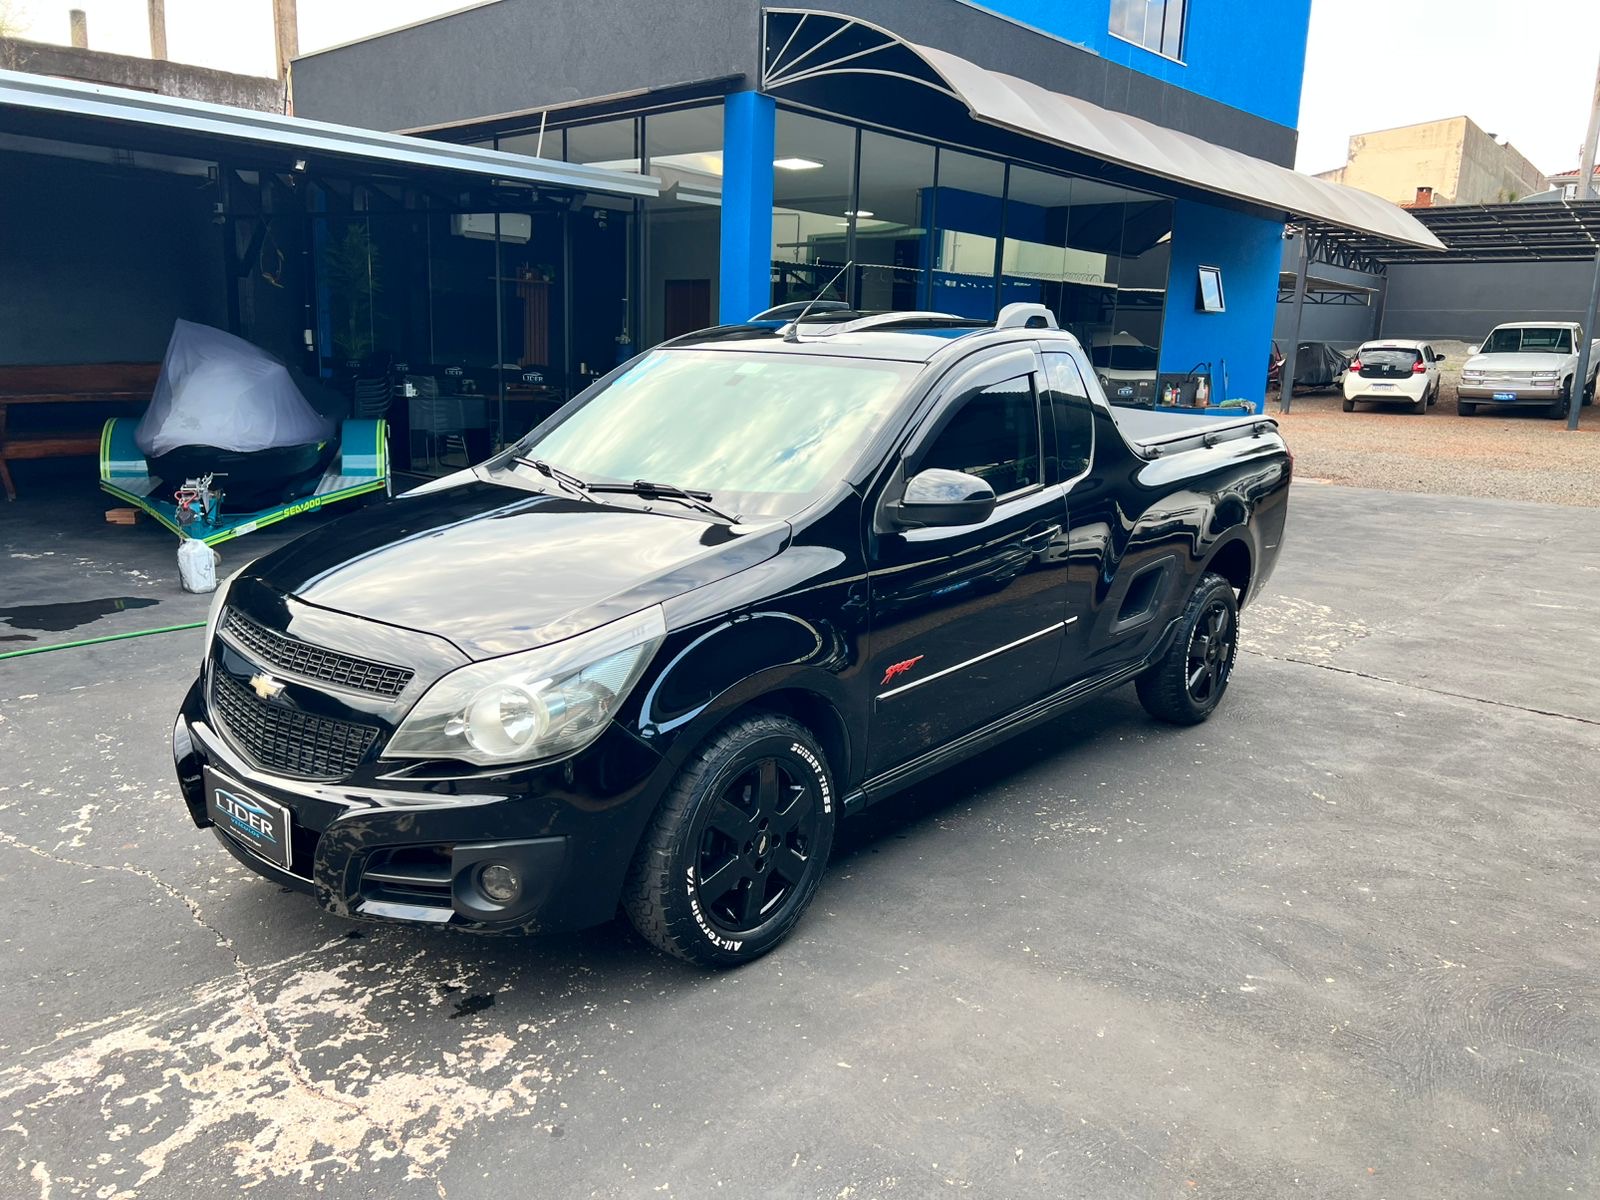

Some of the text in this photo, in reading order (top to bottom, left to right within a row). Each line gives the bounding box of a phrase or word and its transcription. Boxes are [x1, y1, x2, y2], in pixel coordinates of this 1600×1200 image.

[790, 743, 831, 813] SUNSET TIRES
[215, 792, 275, 838] LIDER
[686, 866, 743, 951] All-Terrain T/A
